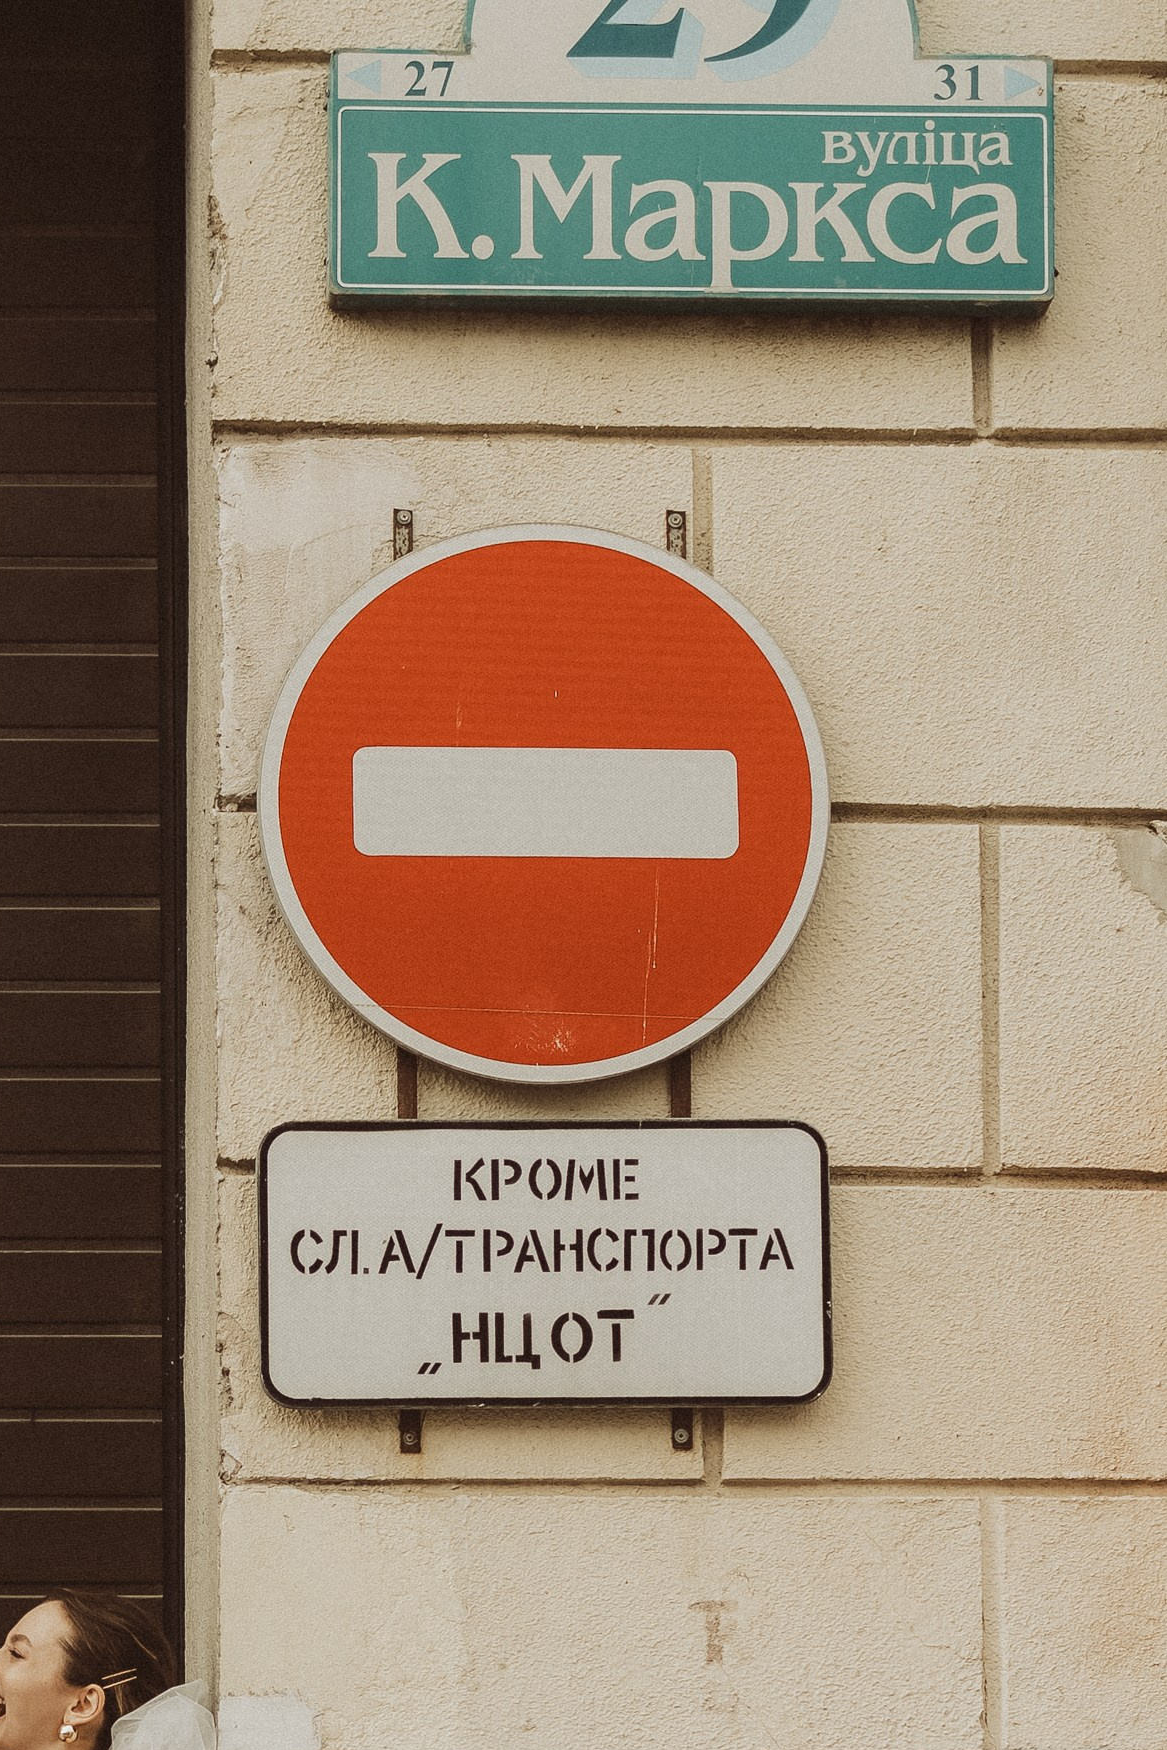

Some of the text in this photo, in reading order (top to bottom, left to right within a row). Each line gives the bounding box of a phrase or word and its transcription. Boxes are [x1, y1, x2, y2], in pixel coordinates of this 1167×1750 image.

[405, 60, 455, 97] 27
[934, 64, 981, 101] 31
[822, 119, 1013, 177] вуліца
[453, 1158, 639, 1201] КРОМЕ
